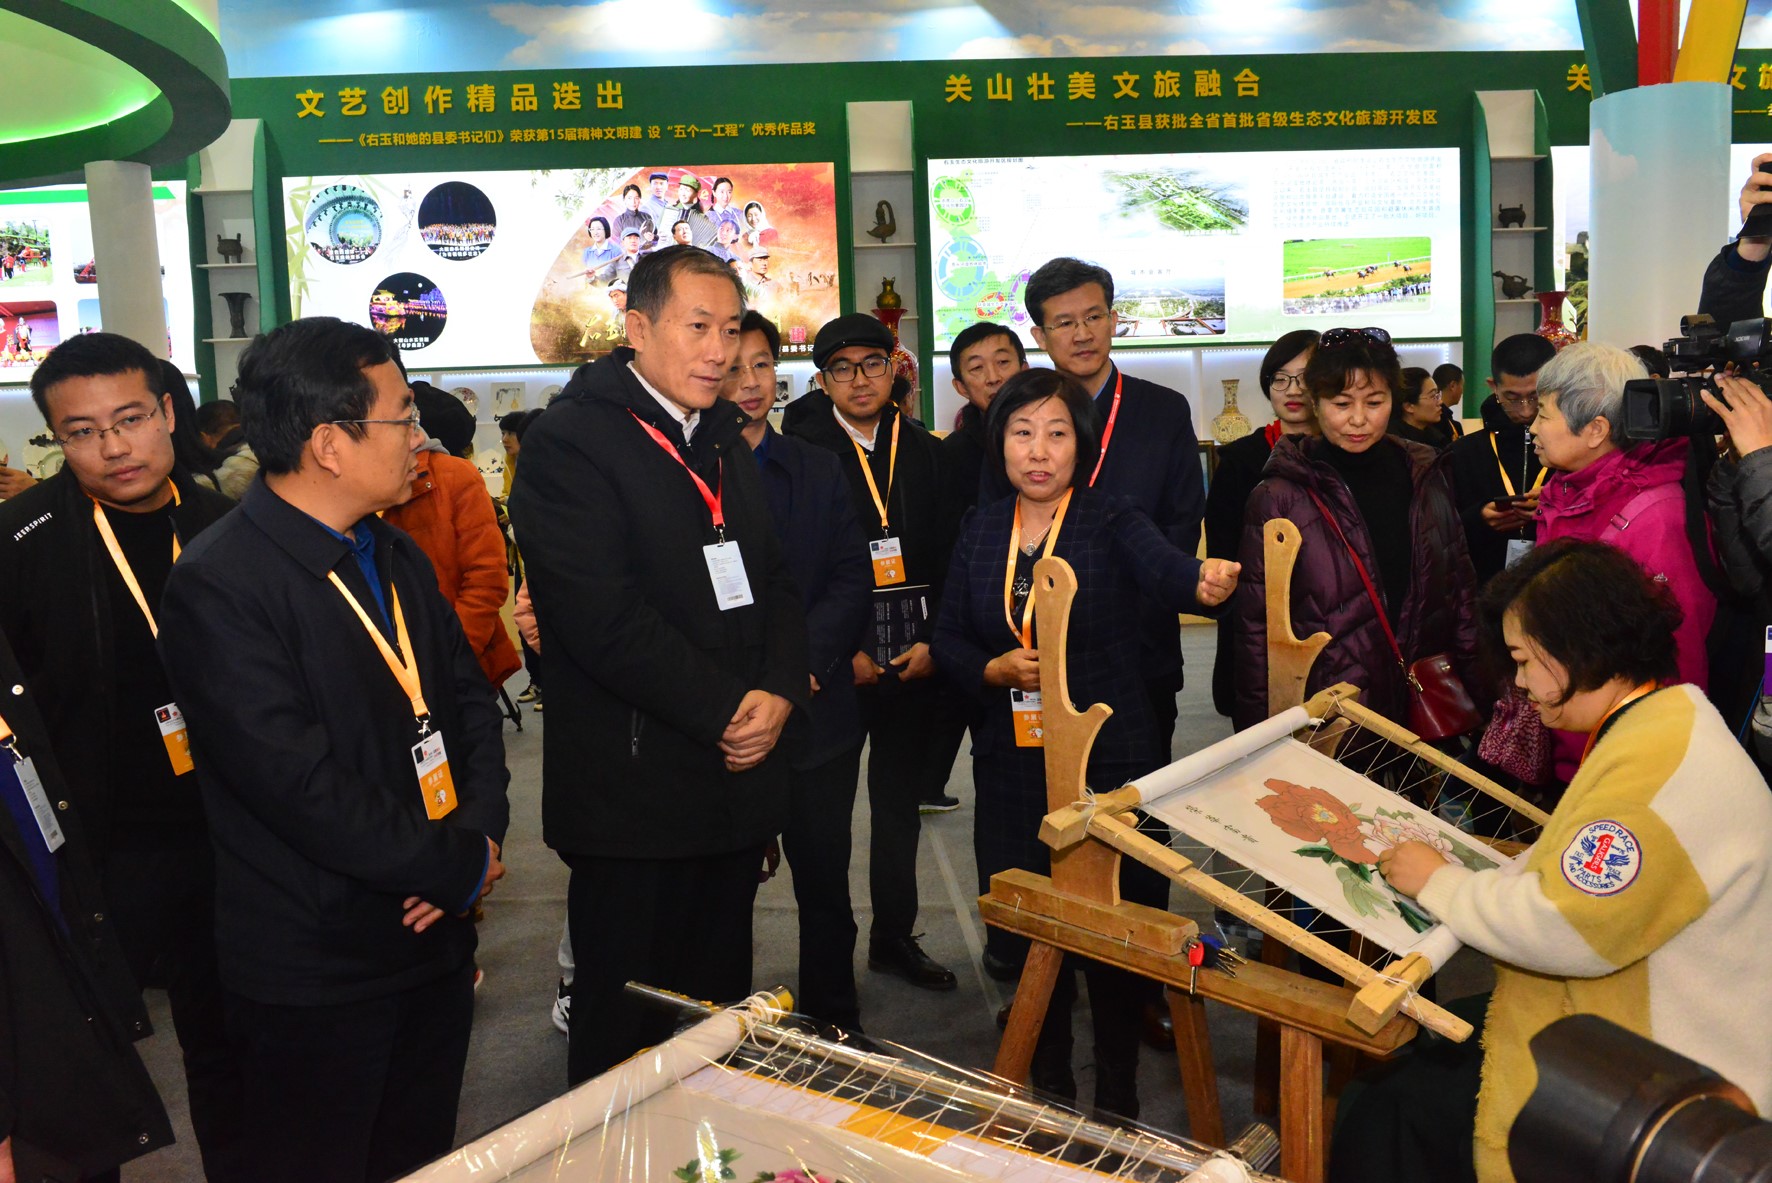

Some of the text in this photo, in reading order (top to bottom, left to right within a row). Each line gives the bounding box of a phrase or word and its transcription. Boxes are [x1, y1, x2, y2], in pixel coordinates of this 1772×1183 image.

[296, 80, 623, 118] 文艺创作精品迭出
[945, 68, 1260, 102] 关山壮美文旅融合
[779, 344, 815, 353] 县委书记
[1589, 824, 1616, 834] SPEED
[1615, 829, 1635, 853] RACE
[1577, 867, 1602, 882] PARTS
